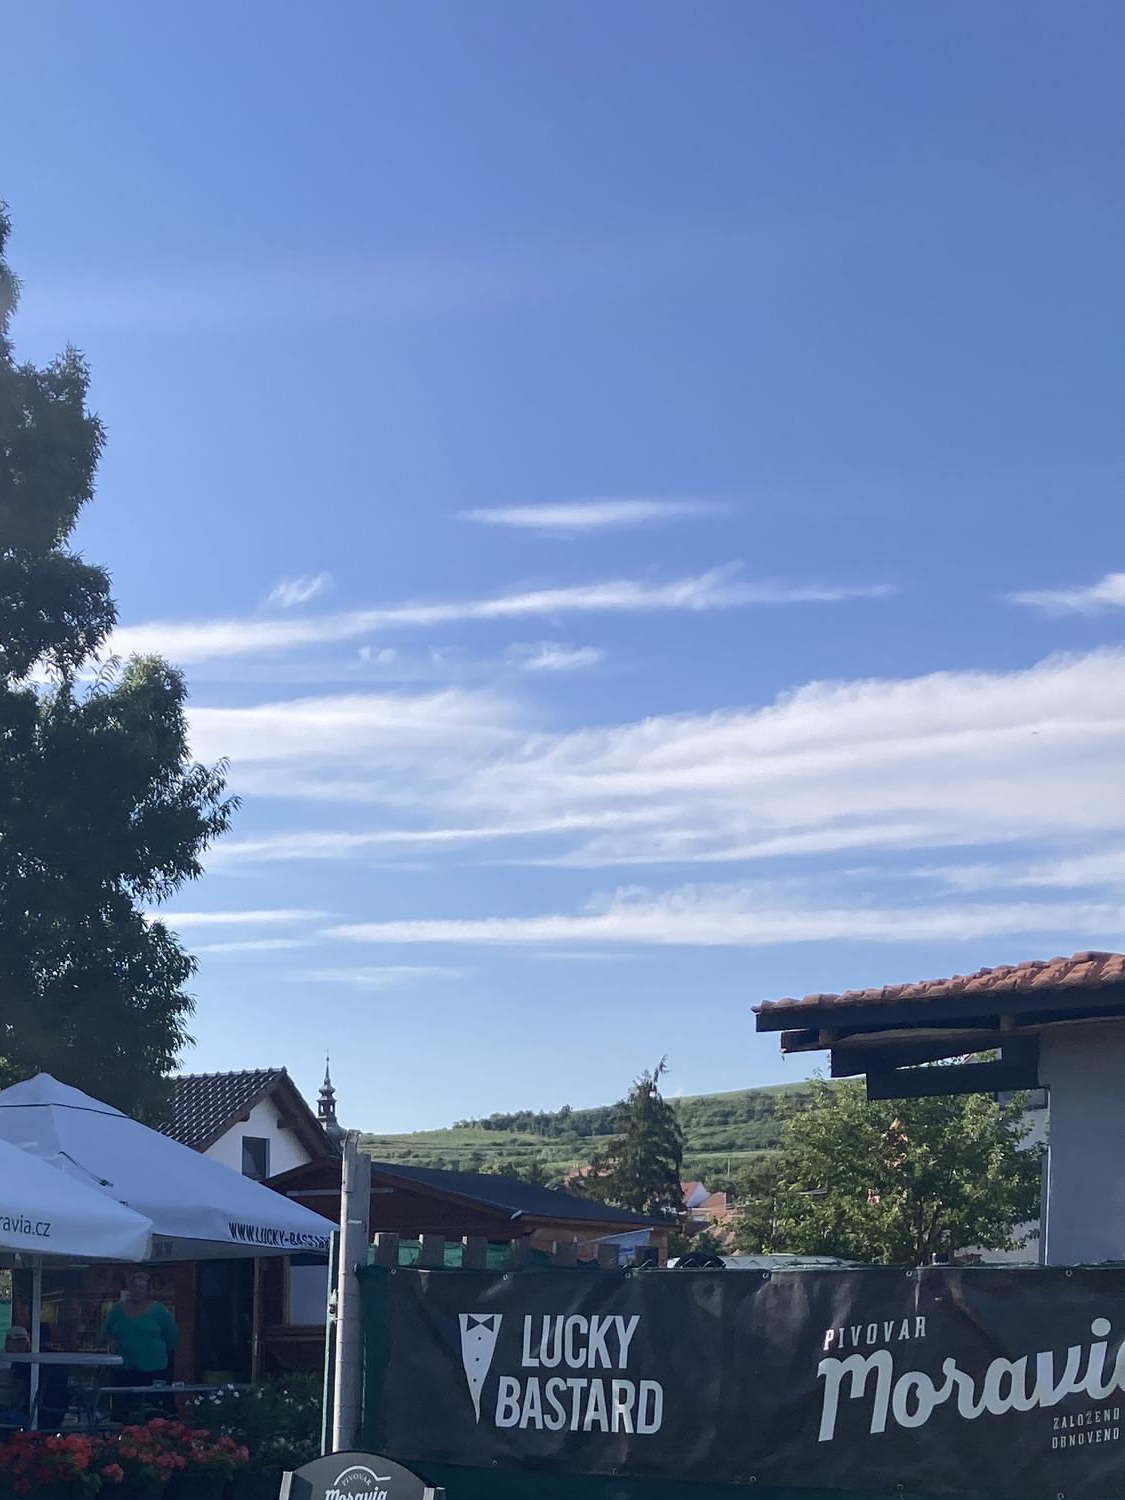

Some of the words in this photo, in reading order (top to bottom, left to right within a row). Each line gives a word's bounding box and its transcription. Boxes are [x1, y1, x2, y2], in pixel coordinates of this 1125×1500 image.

[521, 1314, 641, 1369] LUCKY
[823, 1316, 927, 1351] PIVOVAR
[494, 1375, 664, 1435] BASTARD
[1052, 1407, 1120, 1430] ZALOŽENO
[1051, 1427, 1119, 1449] OBNOVENO
[341, 1473, 372, 1487] PIVOVAR
